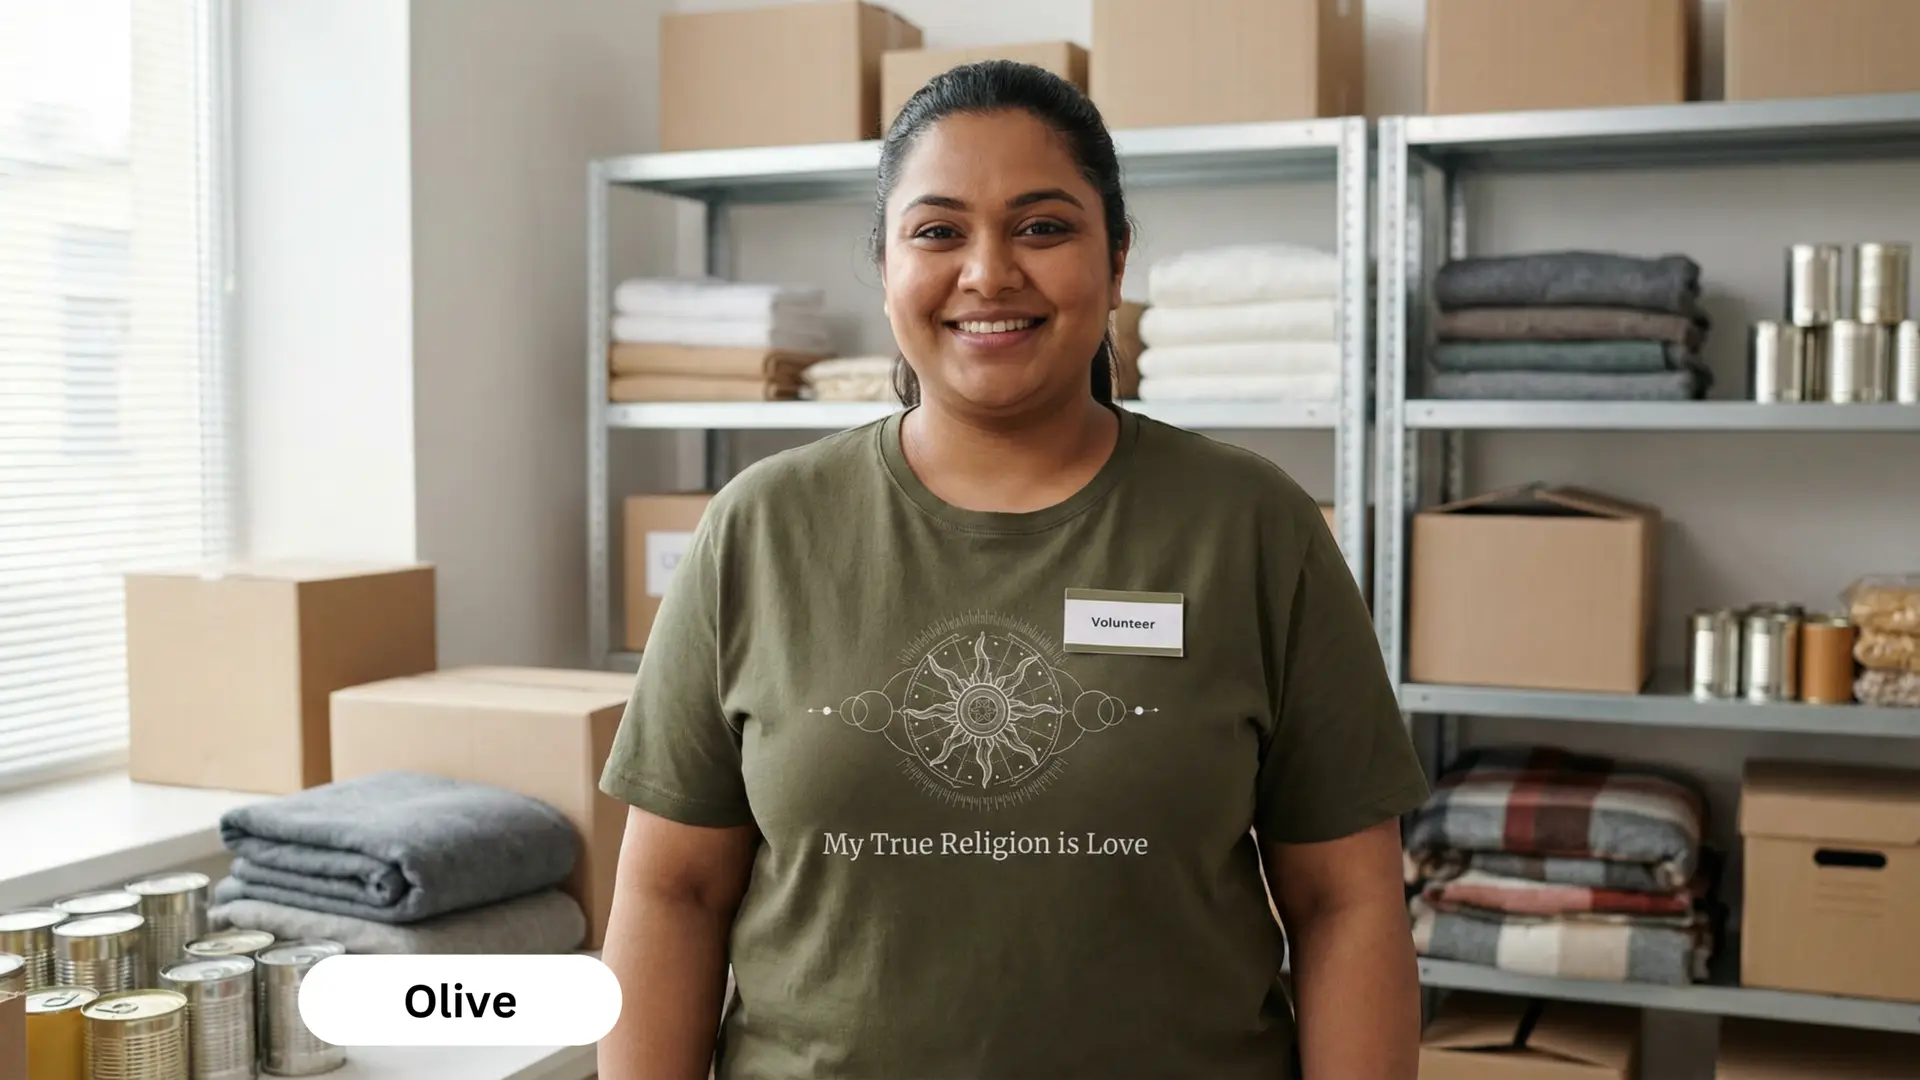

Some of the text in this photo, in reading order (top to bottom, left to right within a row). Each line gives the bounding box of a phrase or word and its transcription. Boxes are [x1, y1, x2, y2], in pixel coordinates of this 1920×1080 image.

[1091, 616, 1156, 630] Volunteer
[823, 830, 1148, 861] My True Religion is Love
